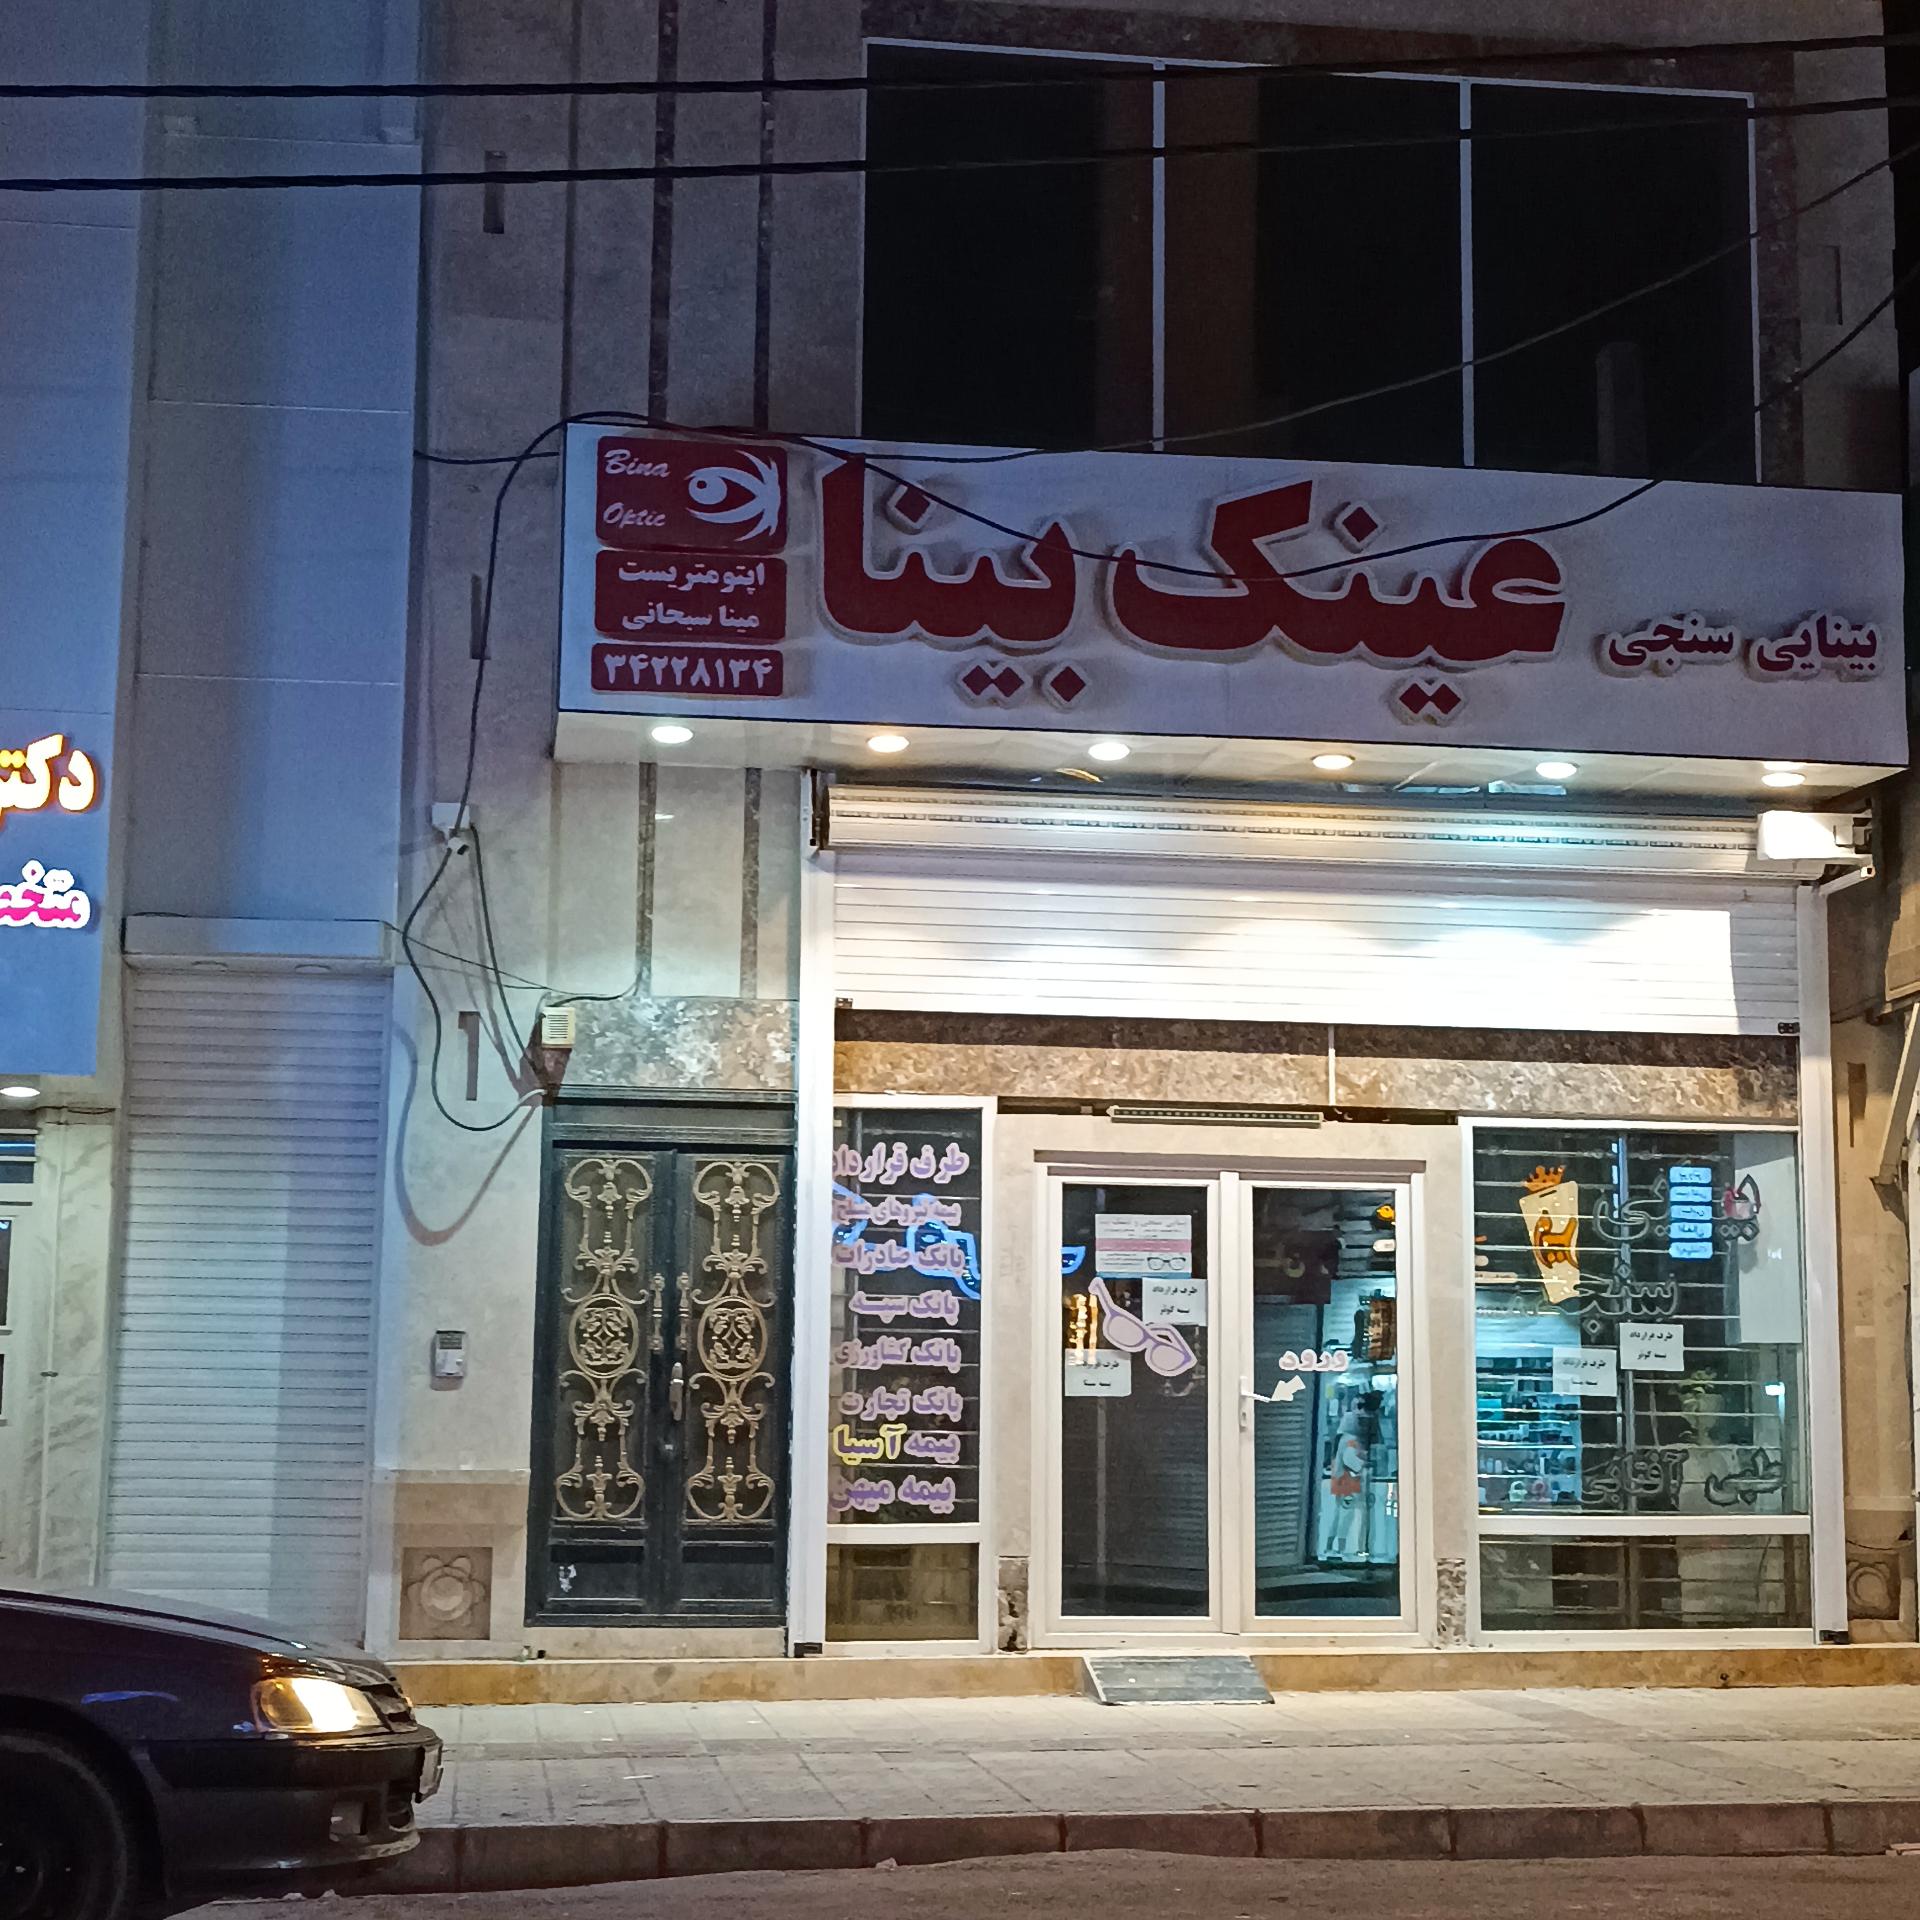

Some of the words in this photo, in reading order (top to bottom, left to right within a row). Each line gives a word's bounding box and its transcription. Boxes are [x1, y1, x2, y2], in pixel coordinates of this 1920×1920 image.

[604, 449, 671, 478] Bina
[603, 501, 668, 529] Optic
[618, 562, 766, 594] اپتومتریست
[820, 454, 1085, 704] بینا
[622, 603, 713, 631] سبحانی
[1110, 479, 1567, 720] عینک
[718, 604, 760, 633] مینا
[1608, 616, 1735, 668] سنجی
[1757, 613, 1877, 672] بینایی
[604, 653, 773, 690] ۳۴۲۲۸۱۳۴
[0, 733, 96, 814] دکت
[909, 1142, 970, 1184] طرف
[832, 1239, 911, 1275] صادرات
[917, 1243, 965, 1278] بانک
[849, 1290, 909, 1324] سپه
[909, 1290, 960, 1326] بانک
[834, 1335, 912, 1370] کشاورزی
[911, 1337, 961, 1373] بانک
[1279, 1349, 1348, 1371] ورود
[838, 1386, 911, 1421] تجارت
[913, 1386, 963, 1422] بانک
[832, 1423, 907, 1465] آسیا
[904, 1432, 961, 1464] بیمه
[829, 1477, 896, 1512] میهن
[898, 1475, 956, 1514] بیمه
